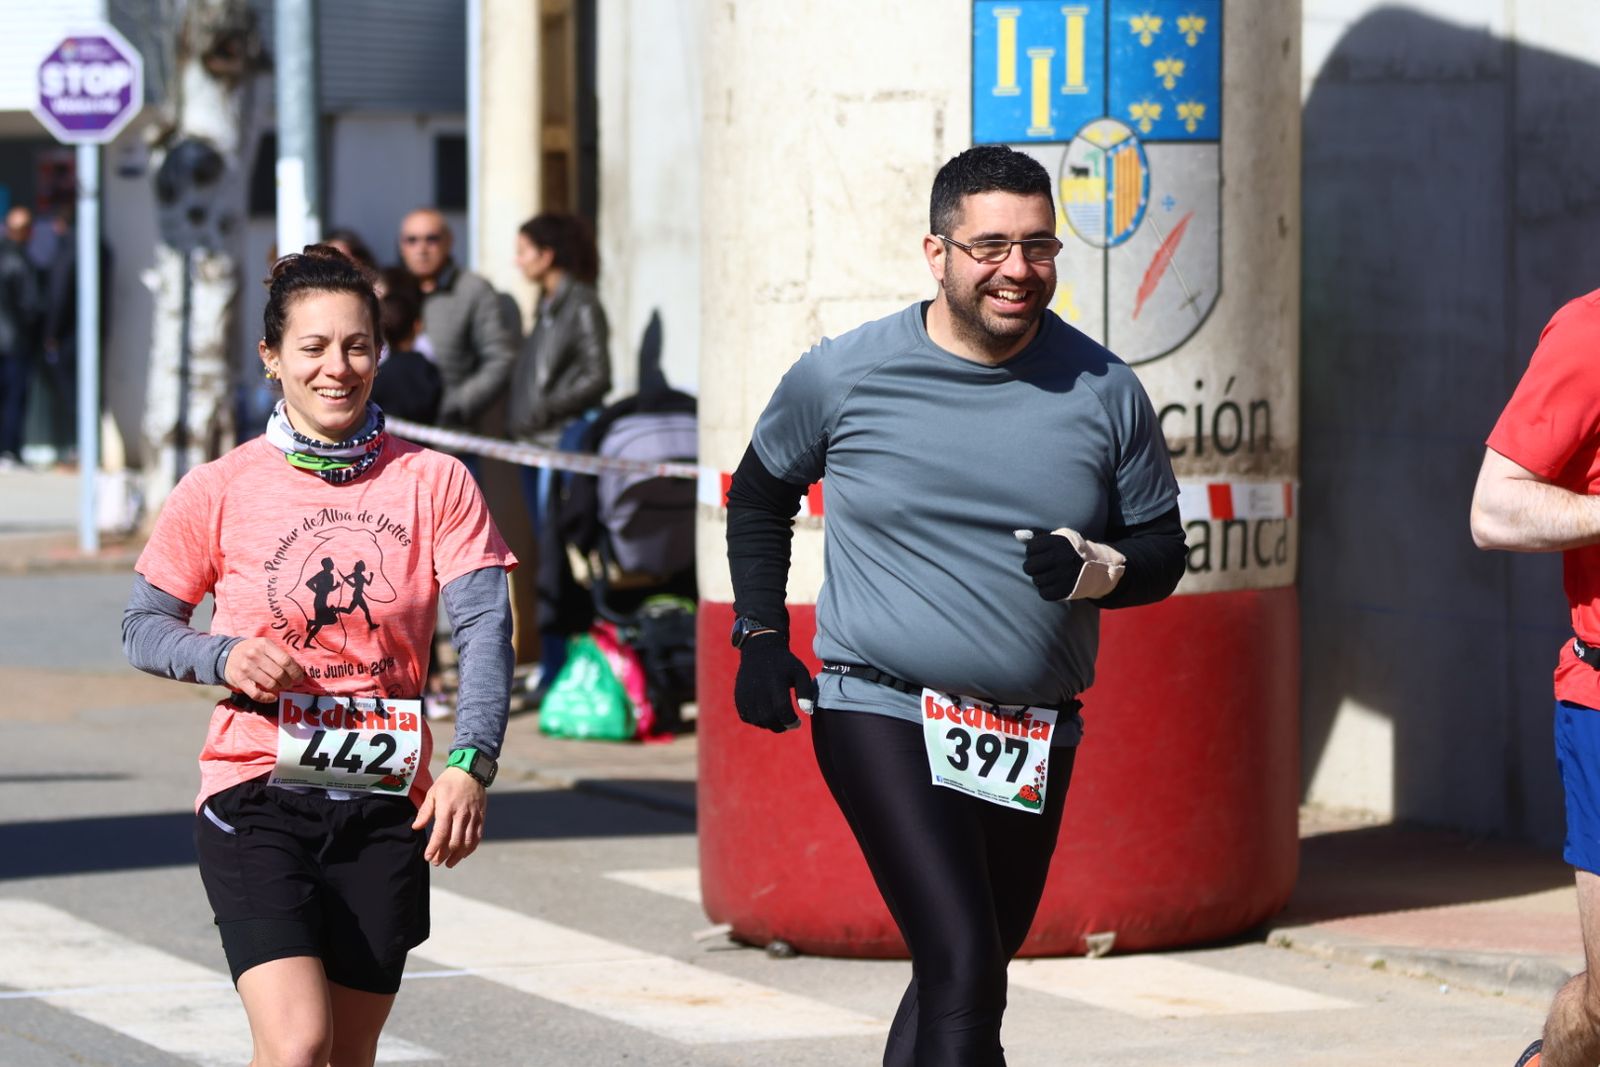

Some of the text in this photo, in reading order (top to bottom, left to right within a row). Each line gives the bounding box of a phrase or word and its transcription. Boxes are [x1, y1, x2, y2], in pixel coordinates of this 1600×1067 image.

[41, 62, 132, 97] STOP
[302, 517, 317, 532] de
[316, 508, 352, 527] Alba
[357, 509, 373, 523] de
[374, 513, 412, 547] Yeltes
[264, 527, 300, 574] Popular
[267, 574, 289, 630] Carrera
[309, 665, 321, 679] de
[925, 695, 1051, 741] bedunia
[299, 730, 397, 775] 442
[946, 727, 1029, 784] 397
